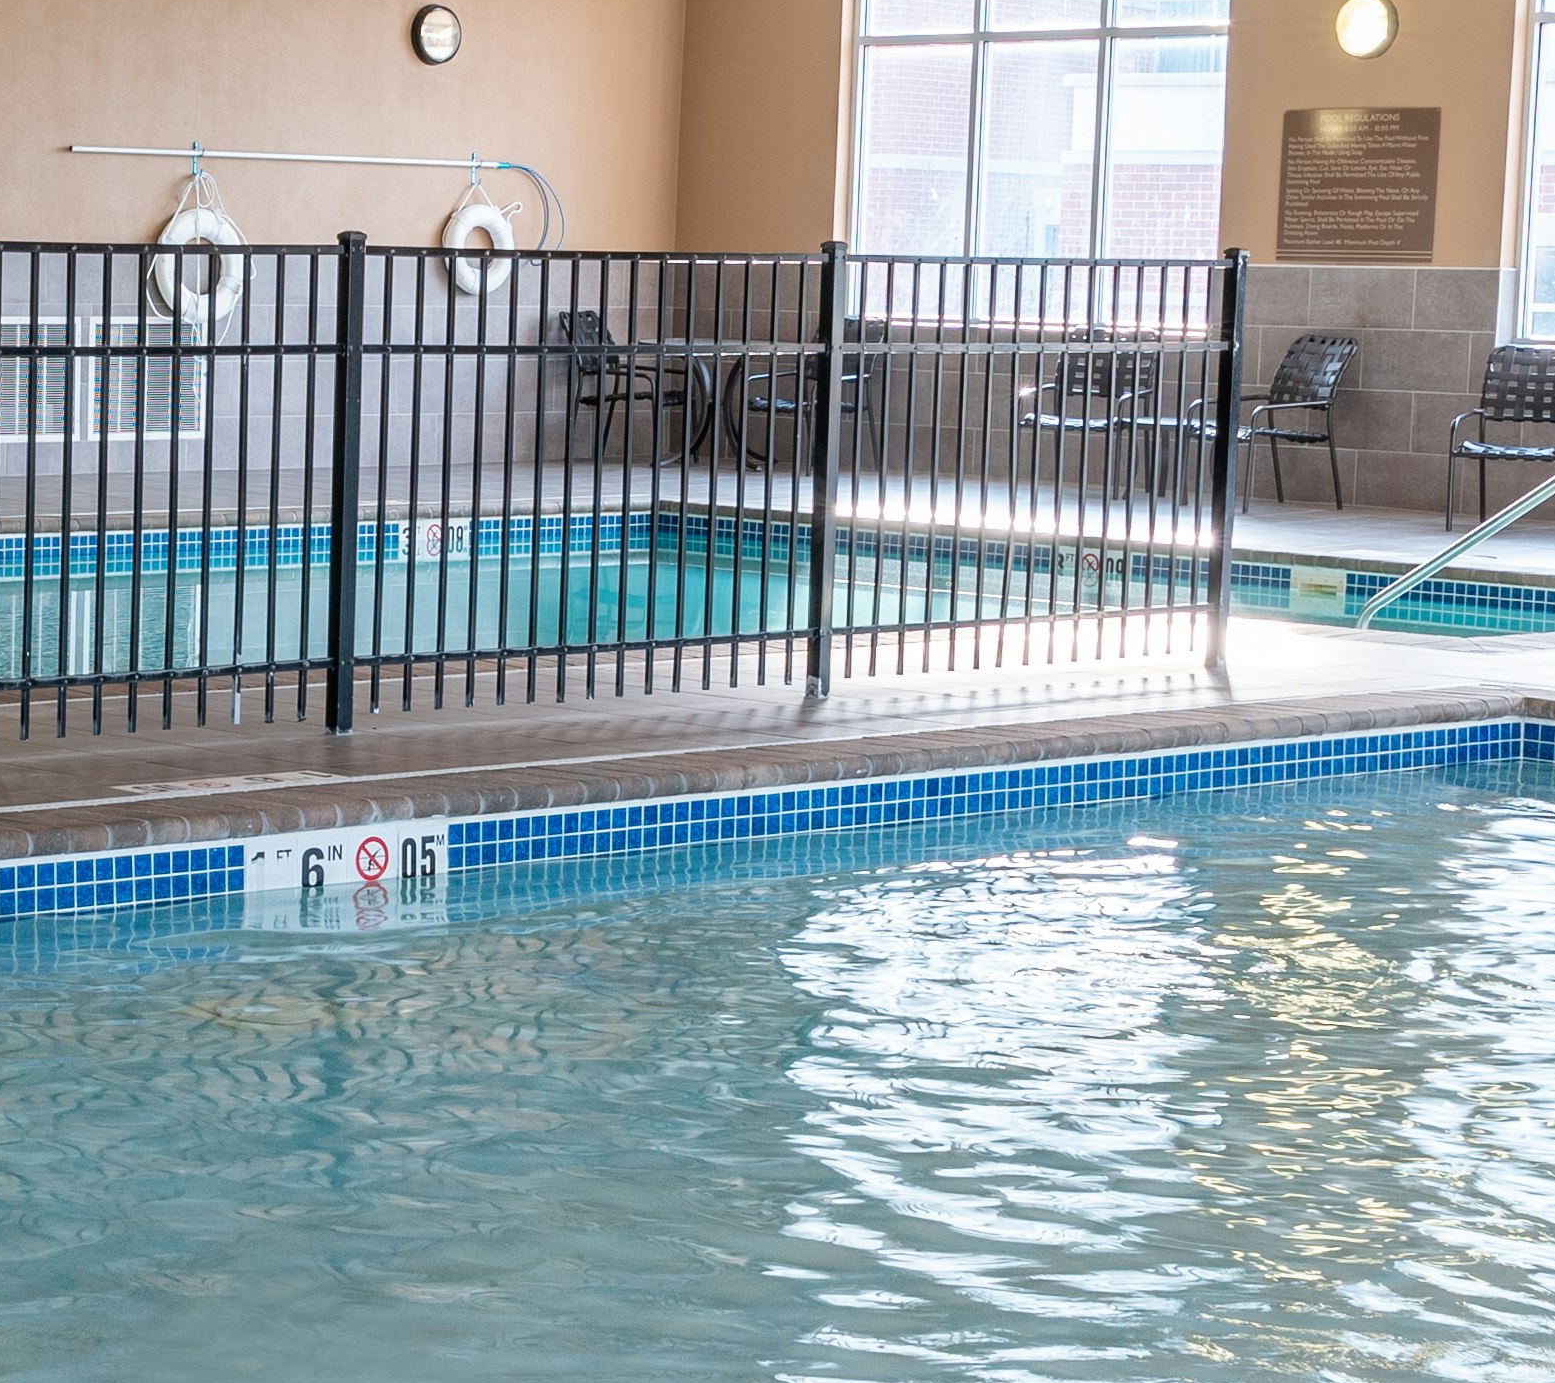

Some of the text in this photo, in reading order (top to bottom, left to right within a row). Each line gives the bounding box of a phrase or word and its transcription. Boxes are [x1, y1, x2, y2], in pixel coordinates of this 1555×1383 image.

[1344, 113, 1400, 122] REGULATIONS
[302, 844, 342, 887] 6 IN
